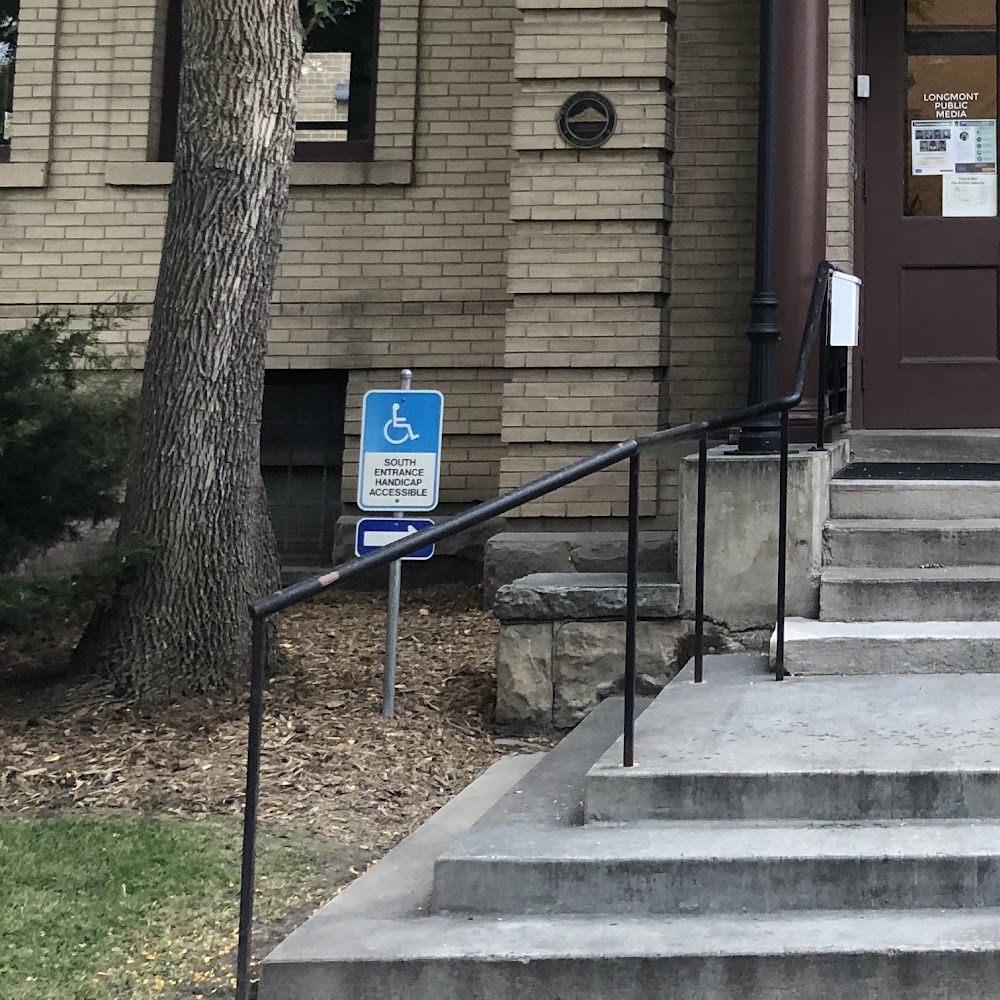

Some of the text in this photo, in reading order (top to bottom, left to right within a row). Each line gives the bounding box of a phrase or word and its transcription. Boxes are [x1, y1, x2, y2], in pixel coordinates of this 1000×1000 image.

[923, 92, 979, 101] LONGMONT
[935, 101, 968, 109] PUBLIC
[936, 110, 967, 118] MEDIA
[384, 458, 416, 466] SOUTH
[374, 468, 424, 476] ENTRANCE
[375, 478, 422, 486] HANDICAP
[369, 488, 428, 496] ACCESSIBLE
